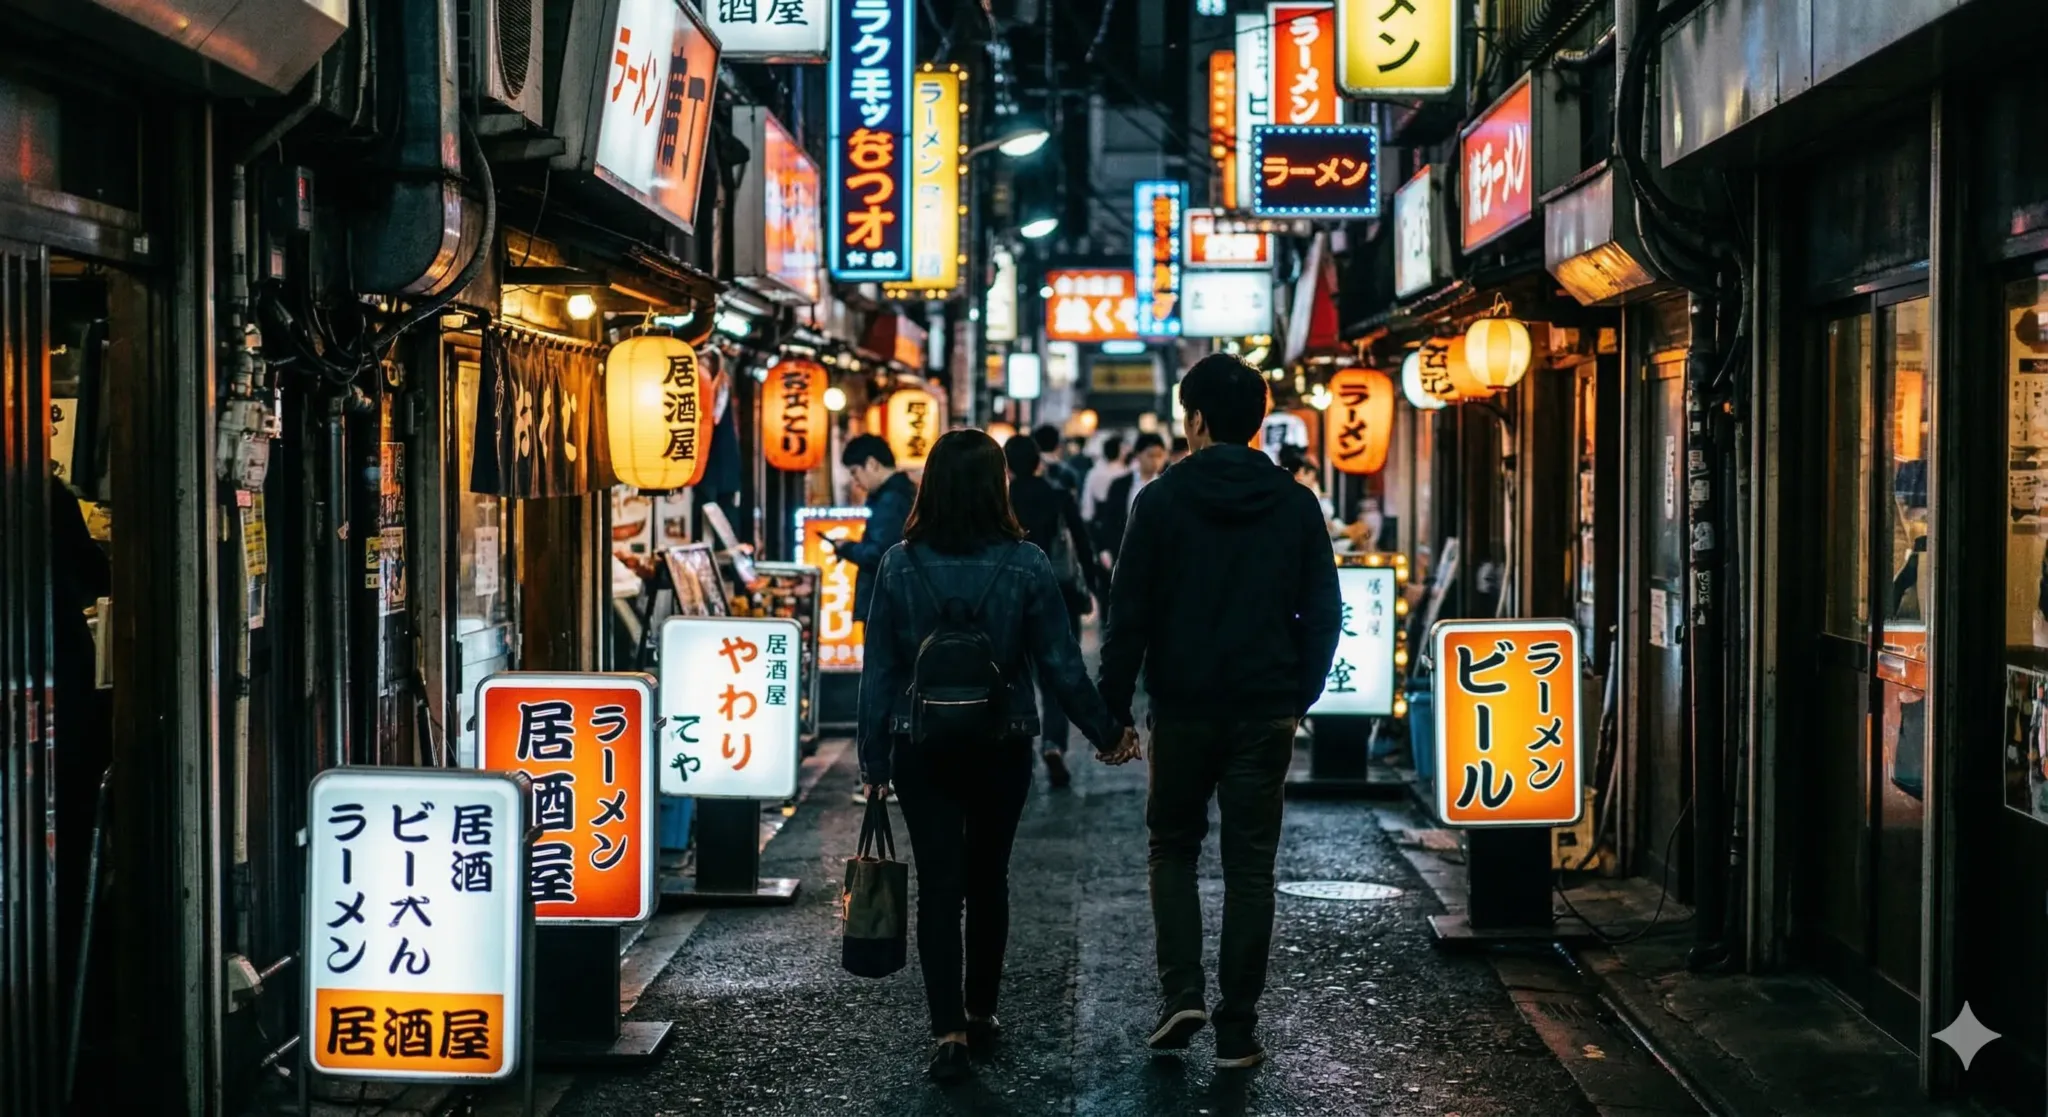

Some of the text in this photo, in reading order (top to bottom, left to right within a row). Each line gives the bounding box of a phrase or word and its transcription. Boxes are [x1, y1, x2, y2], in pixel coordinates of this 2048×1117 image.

[612, 26, 661, 127] ラーメン
[1290, 16, 1319, 124] ラーメン
[920, 82, 942, 175] ラーメン
[1263, 157, 1368, 187] ラーメン
[663, 355, 696, 462] 居酒屋
[1339, 384, 1370, 461] ラーメン
[718, 636, 758, 771] やわり
[765, 634, 787, 705] 居酒屋
[1527, 643, 1564, 790] ラーメン
[1456, 641, 1515, 808] ビール
[590, 705, 628, 870] ラーメン
[327, 803, 367, 974] ラーメン
[451, 804, 493, 892] 居酒
[327, 1006, 492, 1060] 居酒屋
